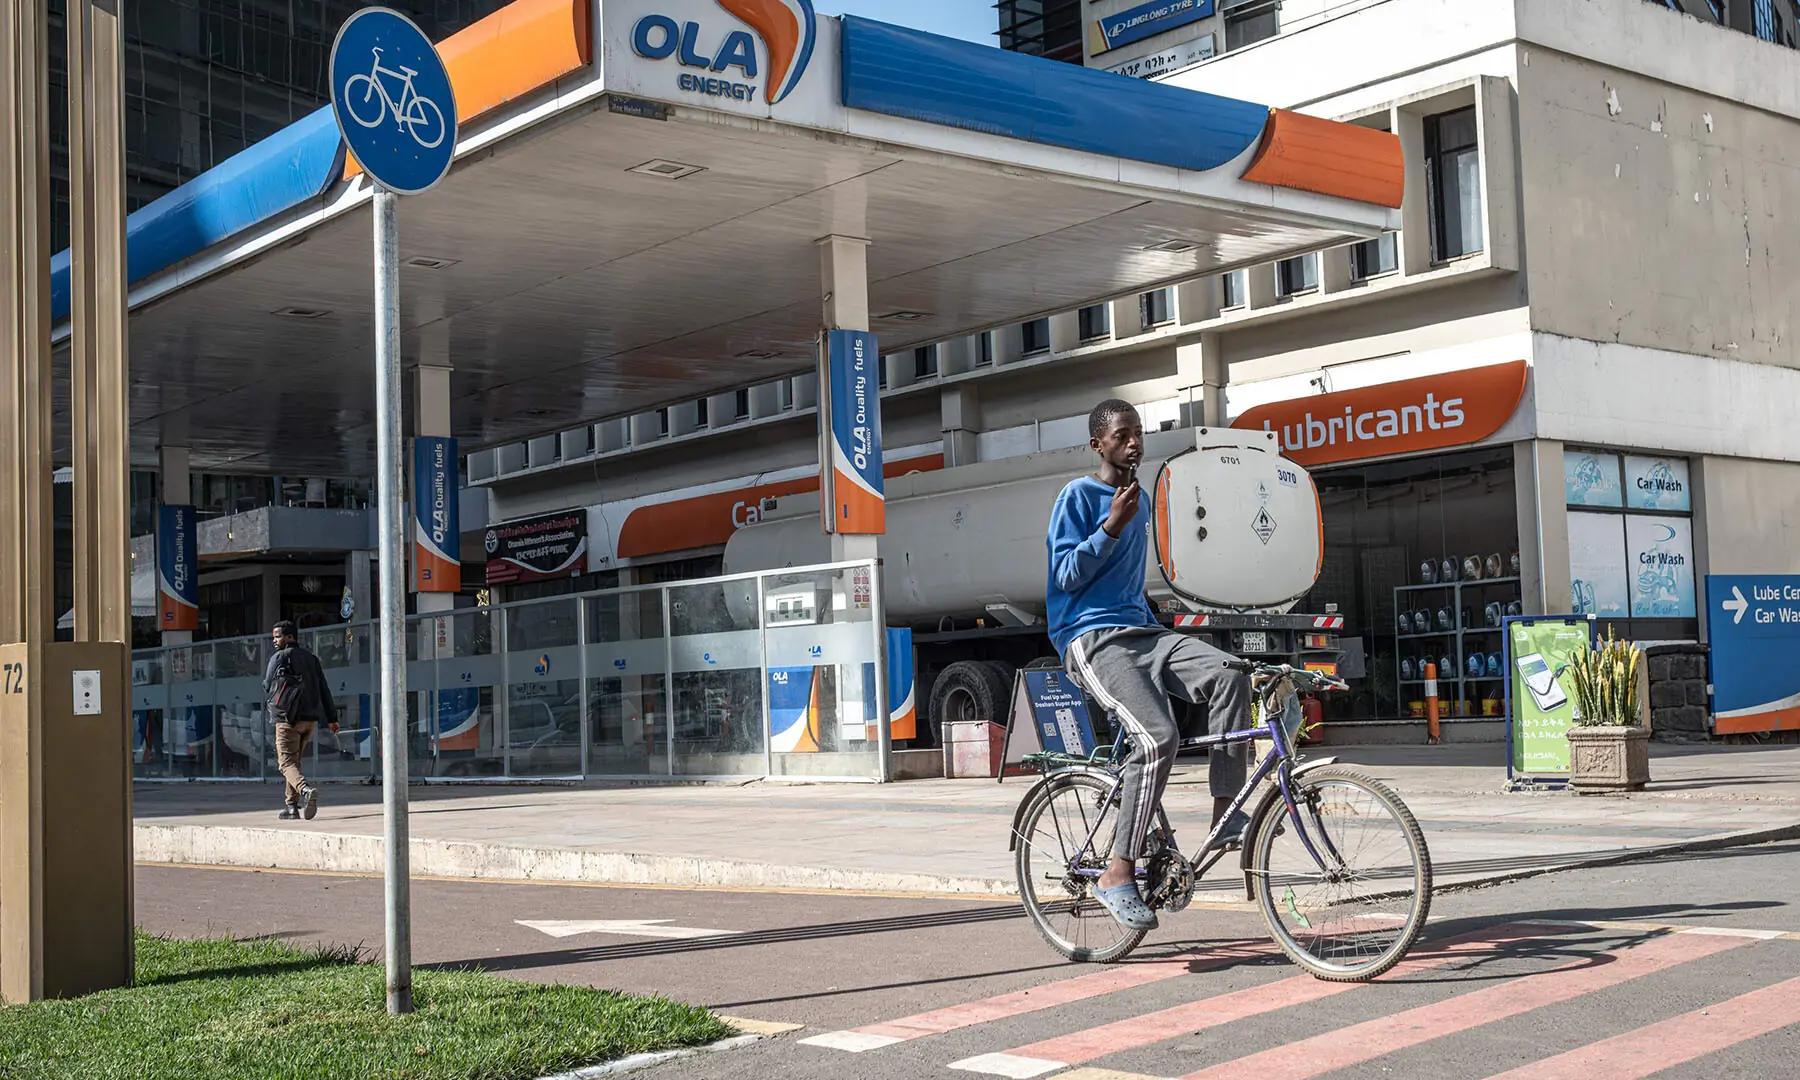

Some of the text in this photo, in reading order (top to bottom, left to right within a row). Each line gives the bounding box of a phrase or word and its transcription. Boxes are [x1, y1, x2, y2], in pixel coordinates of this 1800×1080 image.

[1127, 8, 1168, 28] LINGLONG
[1169, 0, 1193, 11] TYRE
[631, 15, 757, 79] OLA
[678, 73, 756, 101] ENERGY
[853, 338, 867, 470] OLA Quality fuels
[1220, 456, 1241, 465] 6701
[1277, 469, 1297, 484] 3070
[1637, 477, 1683, 492] Car Wash
[432, 443, 445, 544] OLA Quality fuels
[731, 495, 776, 528] Caf
[174, 509, 185, 591] OLA Quality fuels
[1639, 551, 1685, 566] Car Wash
[422, 568, 432, 580] 3
[1753, 585, 1781, 601] Lube
[1755, 608, 1776, 623] Car
[4, 662, 23, 694] 72
[773, 671, 788, 681] OLA
[1052, 694, 1060, 702] Up
